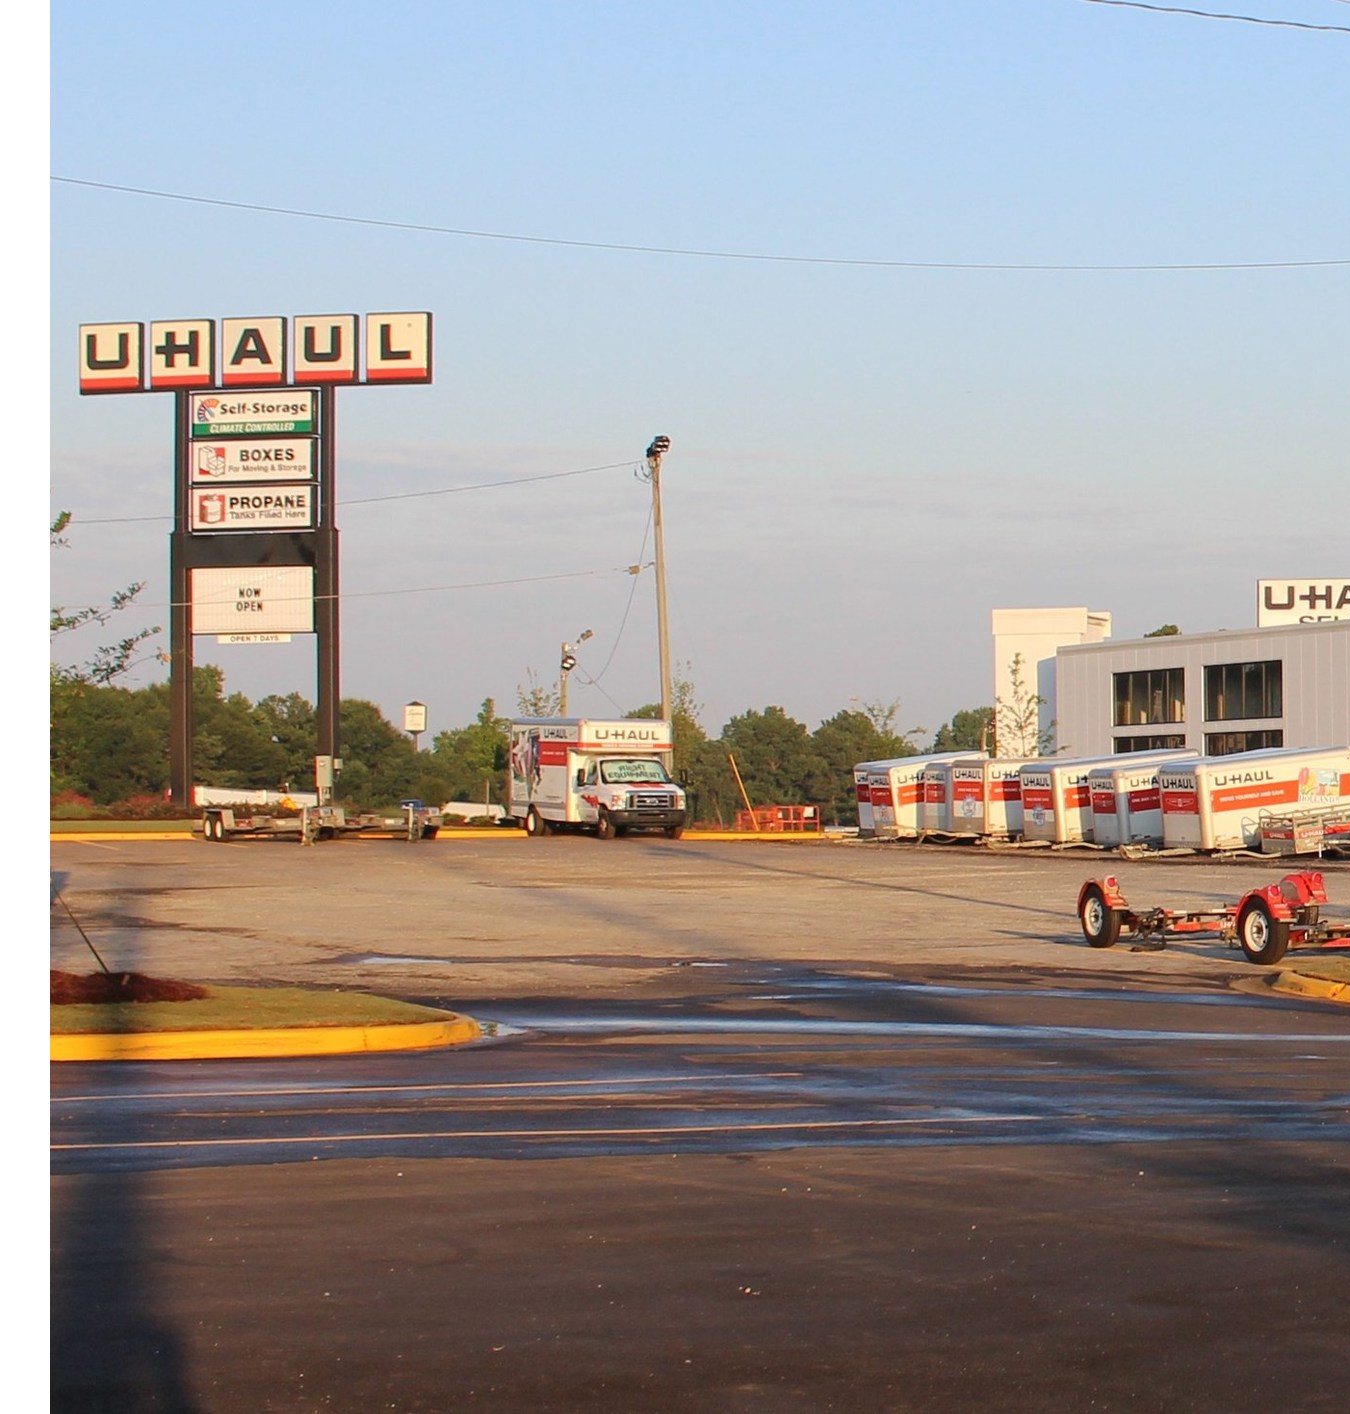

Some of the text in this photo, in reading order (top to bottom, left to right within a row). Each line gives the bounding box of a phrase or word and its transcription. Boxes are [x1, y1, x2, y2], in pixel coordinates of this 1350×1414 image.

[220, 402, 308, 415] Self-Storage
[210, 422, 295, 434] CLIMATE CONTROLLED
[240, 448, 295, 462] BOXES
[242, 464, 269, 474] Moving
[278, 463, 307, 473] Storage
[229, 495, 306, 509] PROPANE
[230, 509, 307, 519] Tanks Filled Here
[239, 588, 262, 598] NOW
[236, 602, 263, 612] OPEN
[595, 730, 660, 741] U-HAUL
[955, 769, 982, 780] U-HAUL
[1214, 770, 1274, 786] U-HAUL
[1023, 776, 1050, 787] U-HAUL
[1162, 777, 1195, 789] U-HAUL
